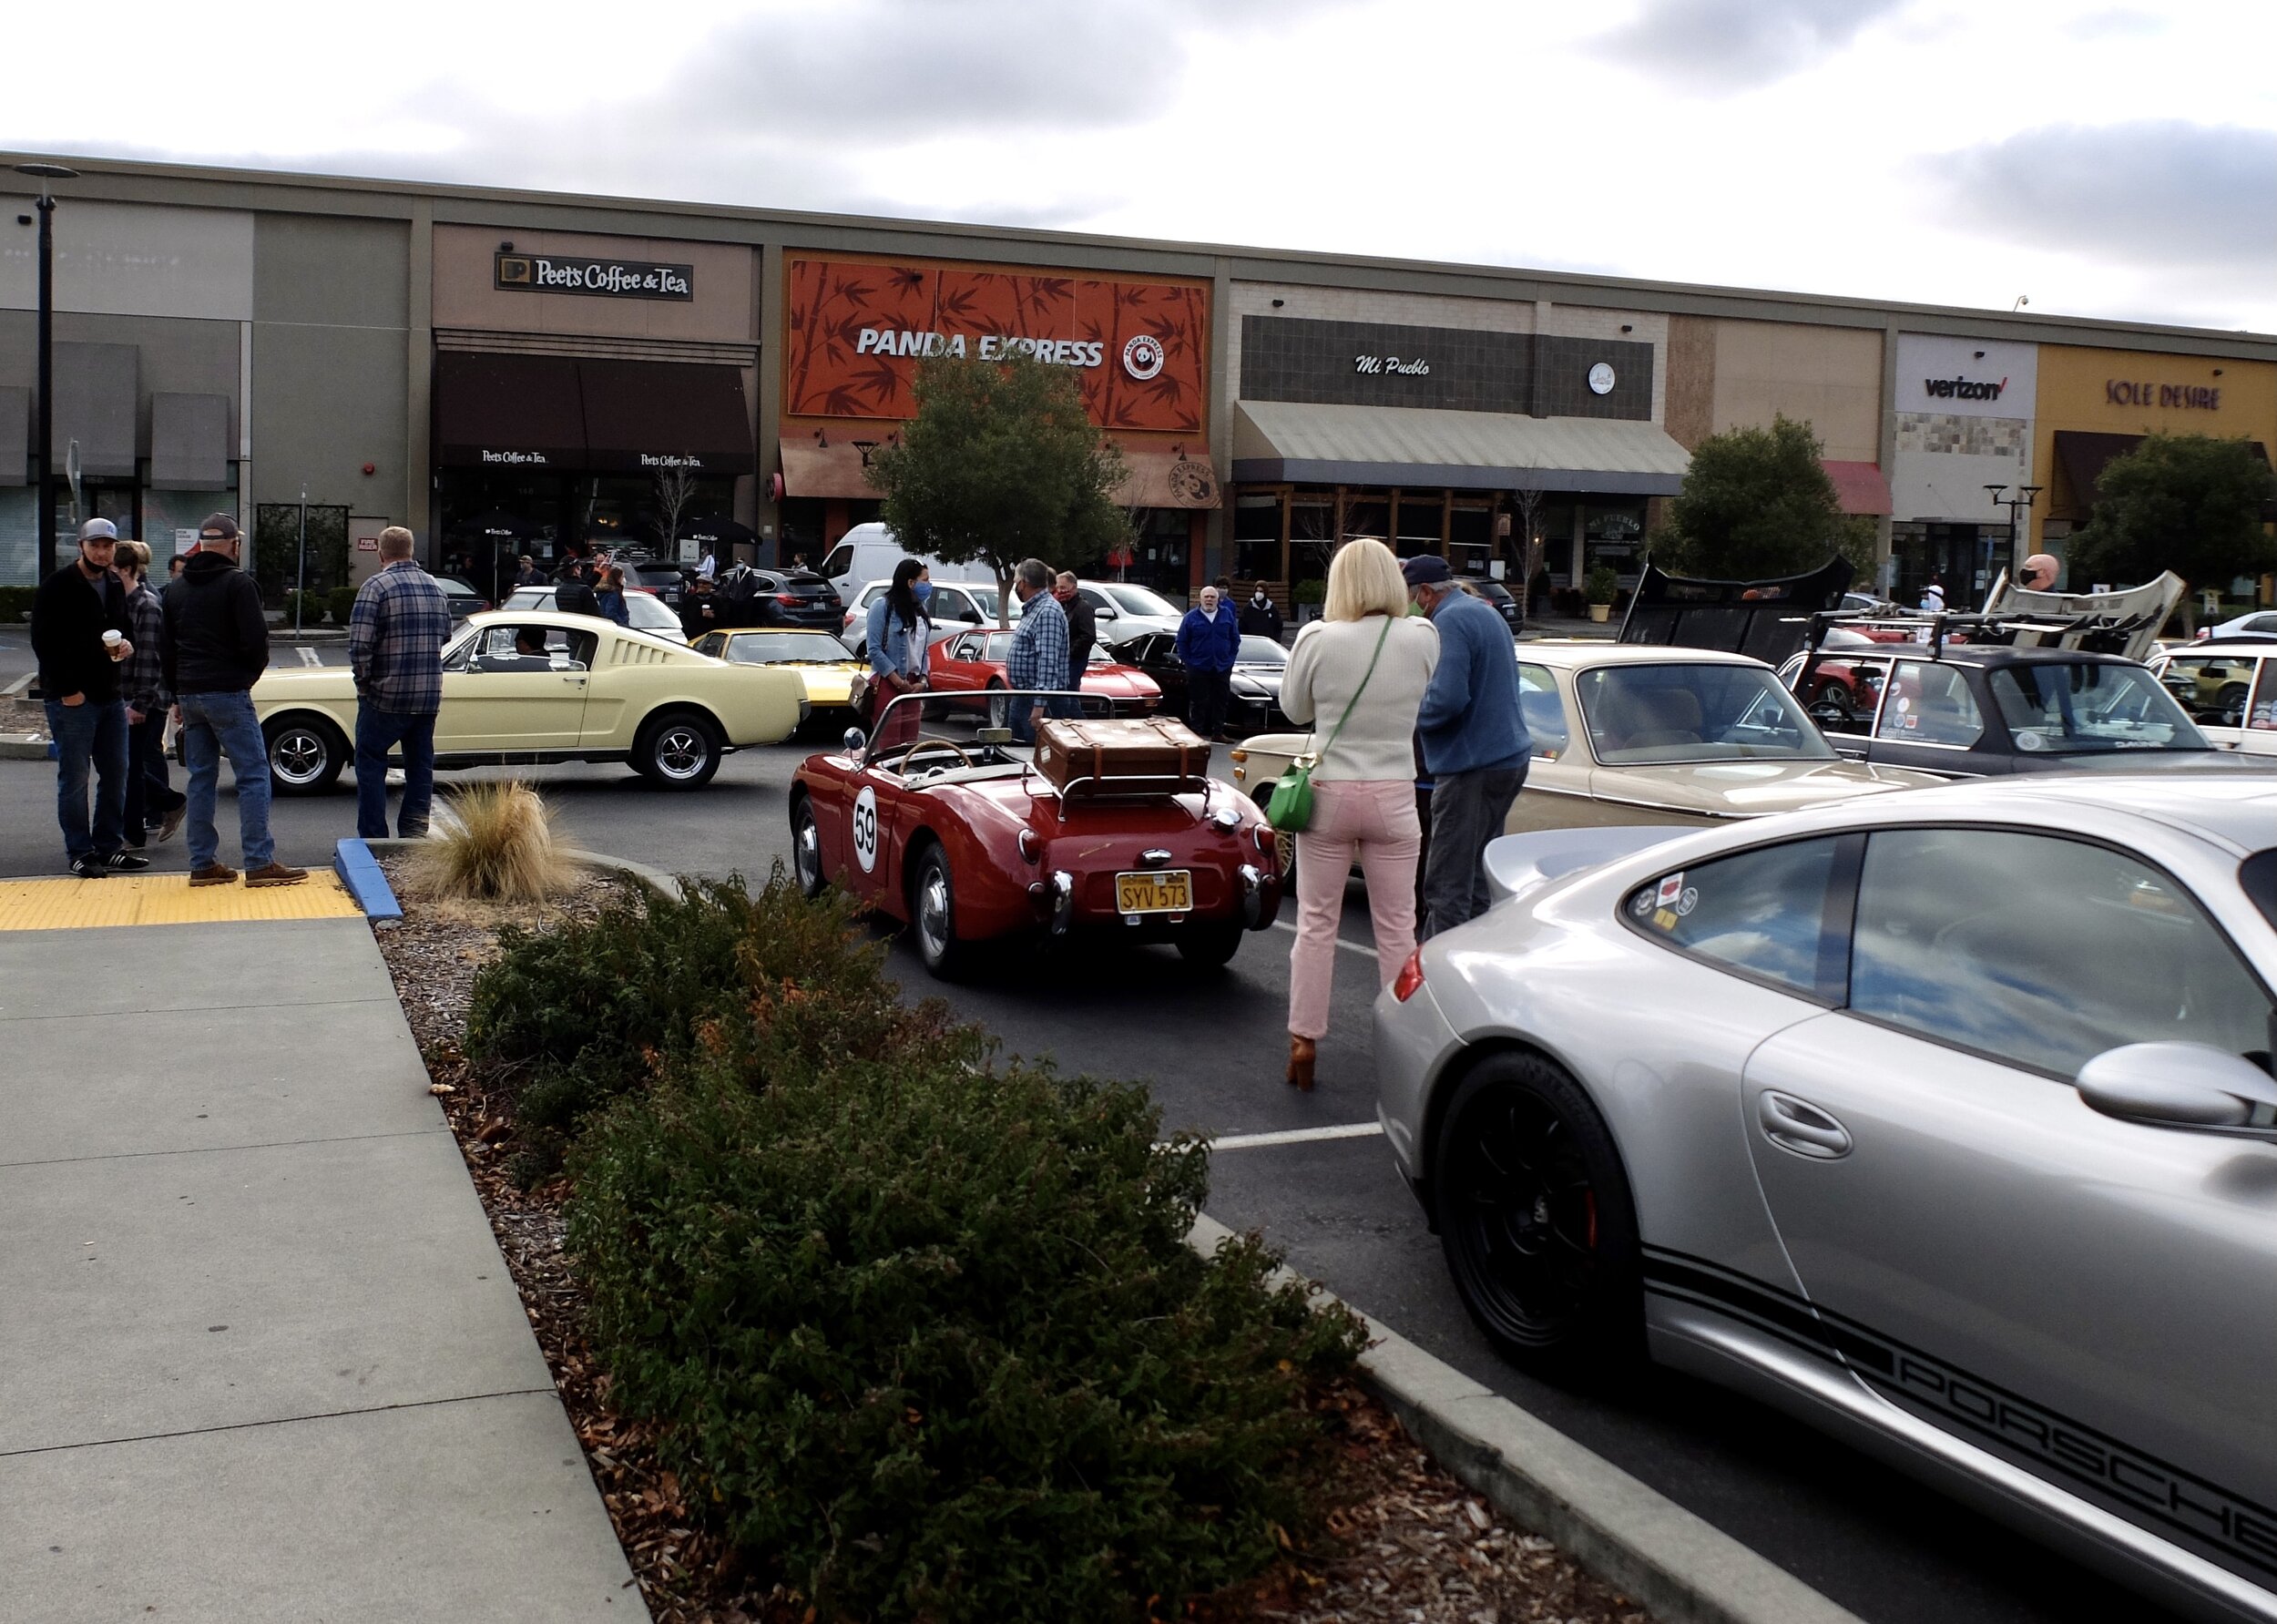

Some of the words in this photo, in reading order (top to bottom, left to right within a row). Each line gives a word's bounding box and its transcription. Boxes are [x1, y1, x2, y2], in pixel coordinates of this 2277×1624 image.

[536, 260, 582, 287] Peet's
[585, 264, 641, 292] Coffee
[642, 274, 659, 289] &
[655, 268, 688, 293] Tea
[856, 328, 966, 359] PANDA
[978, 334, 1104, 367] EXPRESS
[1126, 337, 1141, 356] PANDA
[1143, 336, 1163, 358] EXPRESS
[1355, 355, 1382, 373] Mi
[1385, 356, 1429, 374] Pueblo
[1925, 375, 1999, 401] verizon
[2105, 379, 2154, 405] SOLE
[2160, 383, 2221, 410] DESIRE
[503, 451, 526, 464] Coffee
[531, 452, 546, 463] Tea
[660, 455, 681, 467] Coffee
[688, 455, 700, 466] Tea
[855, 803, 875, 854] 59
[1123, 886, 1154, 908] SYV
[1159, 885, 1188, 906] 573
[1900, 1356, 2277, 1558] PORSCHE
